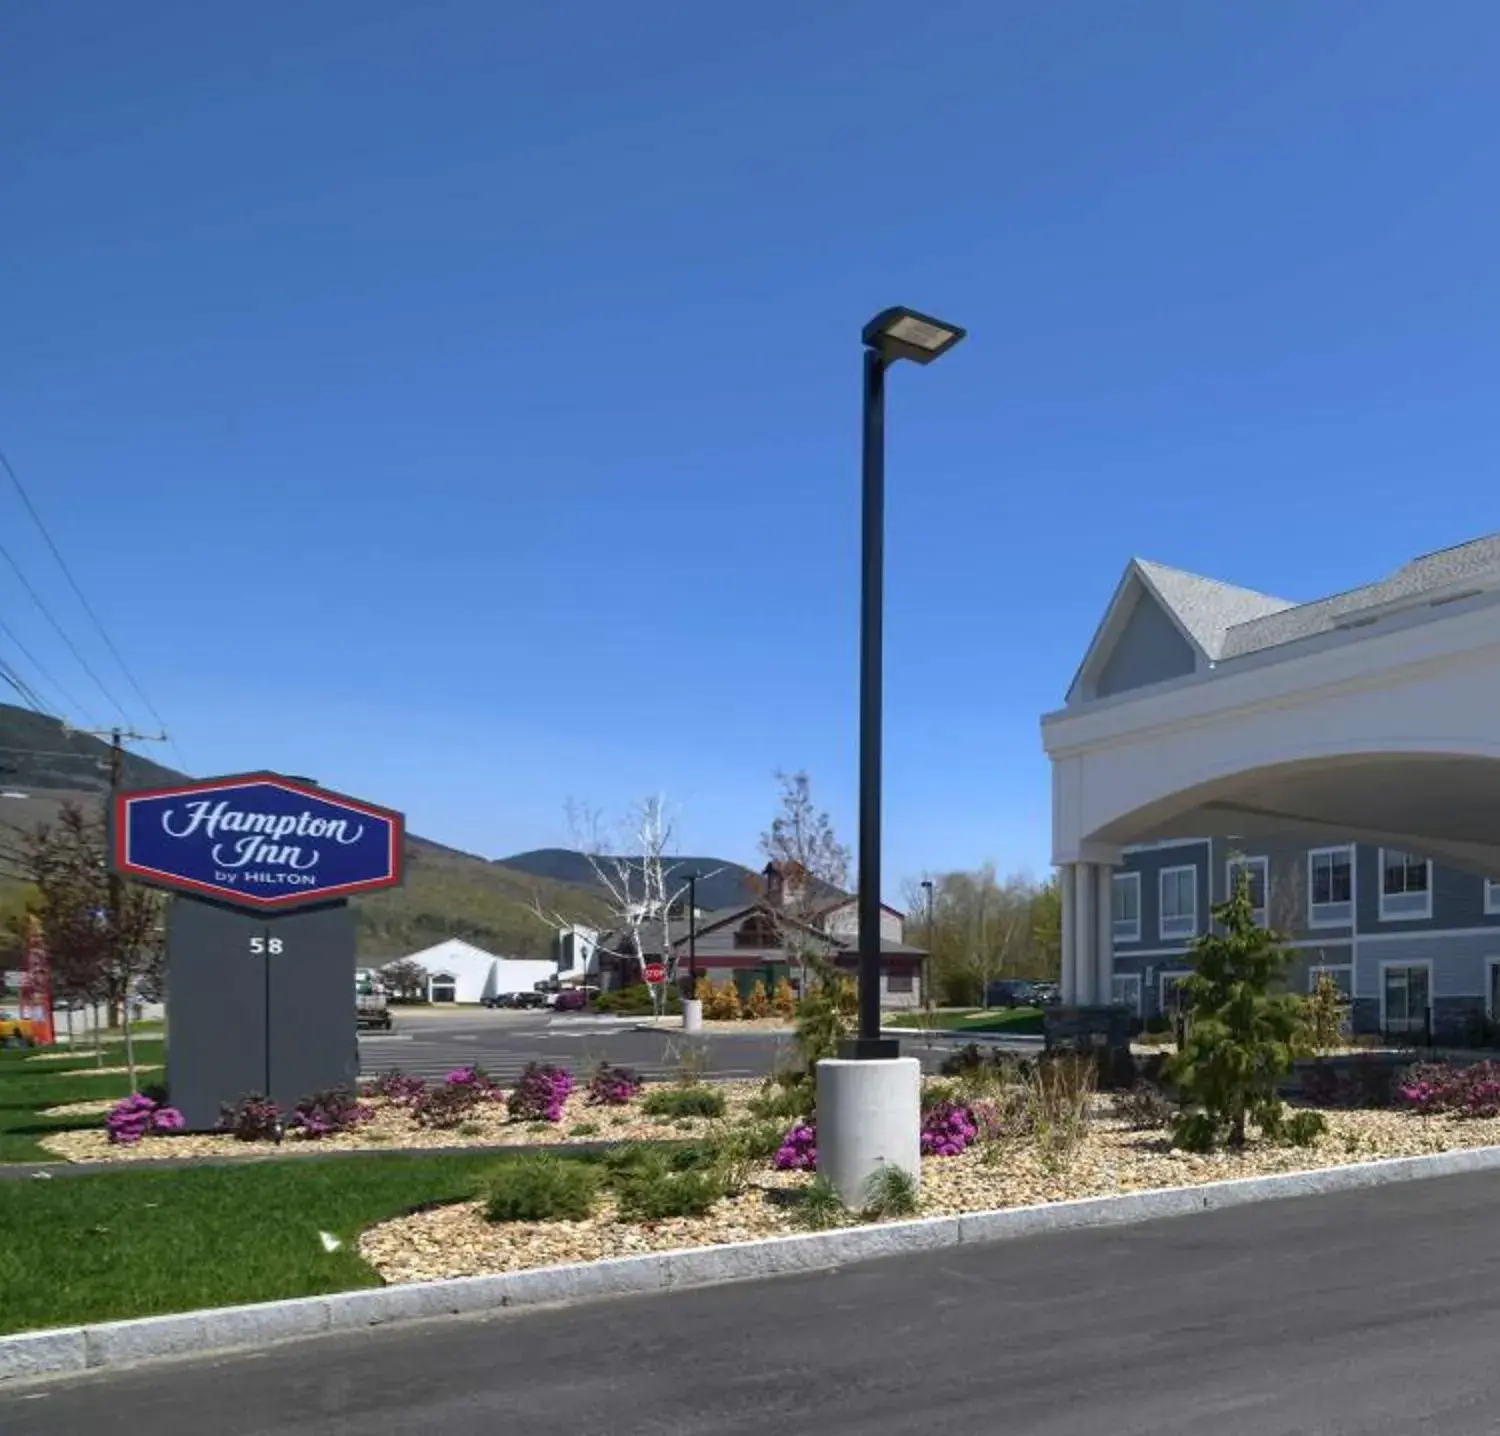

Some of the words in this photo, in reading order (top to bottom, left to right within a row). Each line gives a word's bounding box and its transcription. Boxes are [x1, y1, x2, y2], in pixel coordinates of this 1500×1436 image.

[162, 801, 363, 844] Hampton
[211, 836, 320, 869] Inn
[214, 871, 237, 883] by
[244, 871, 315, 885] HILTON
[249, 937, 284, 954] 58
